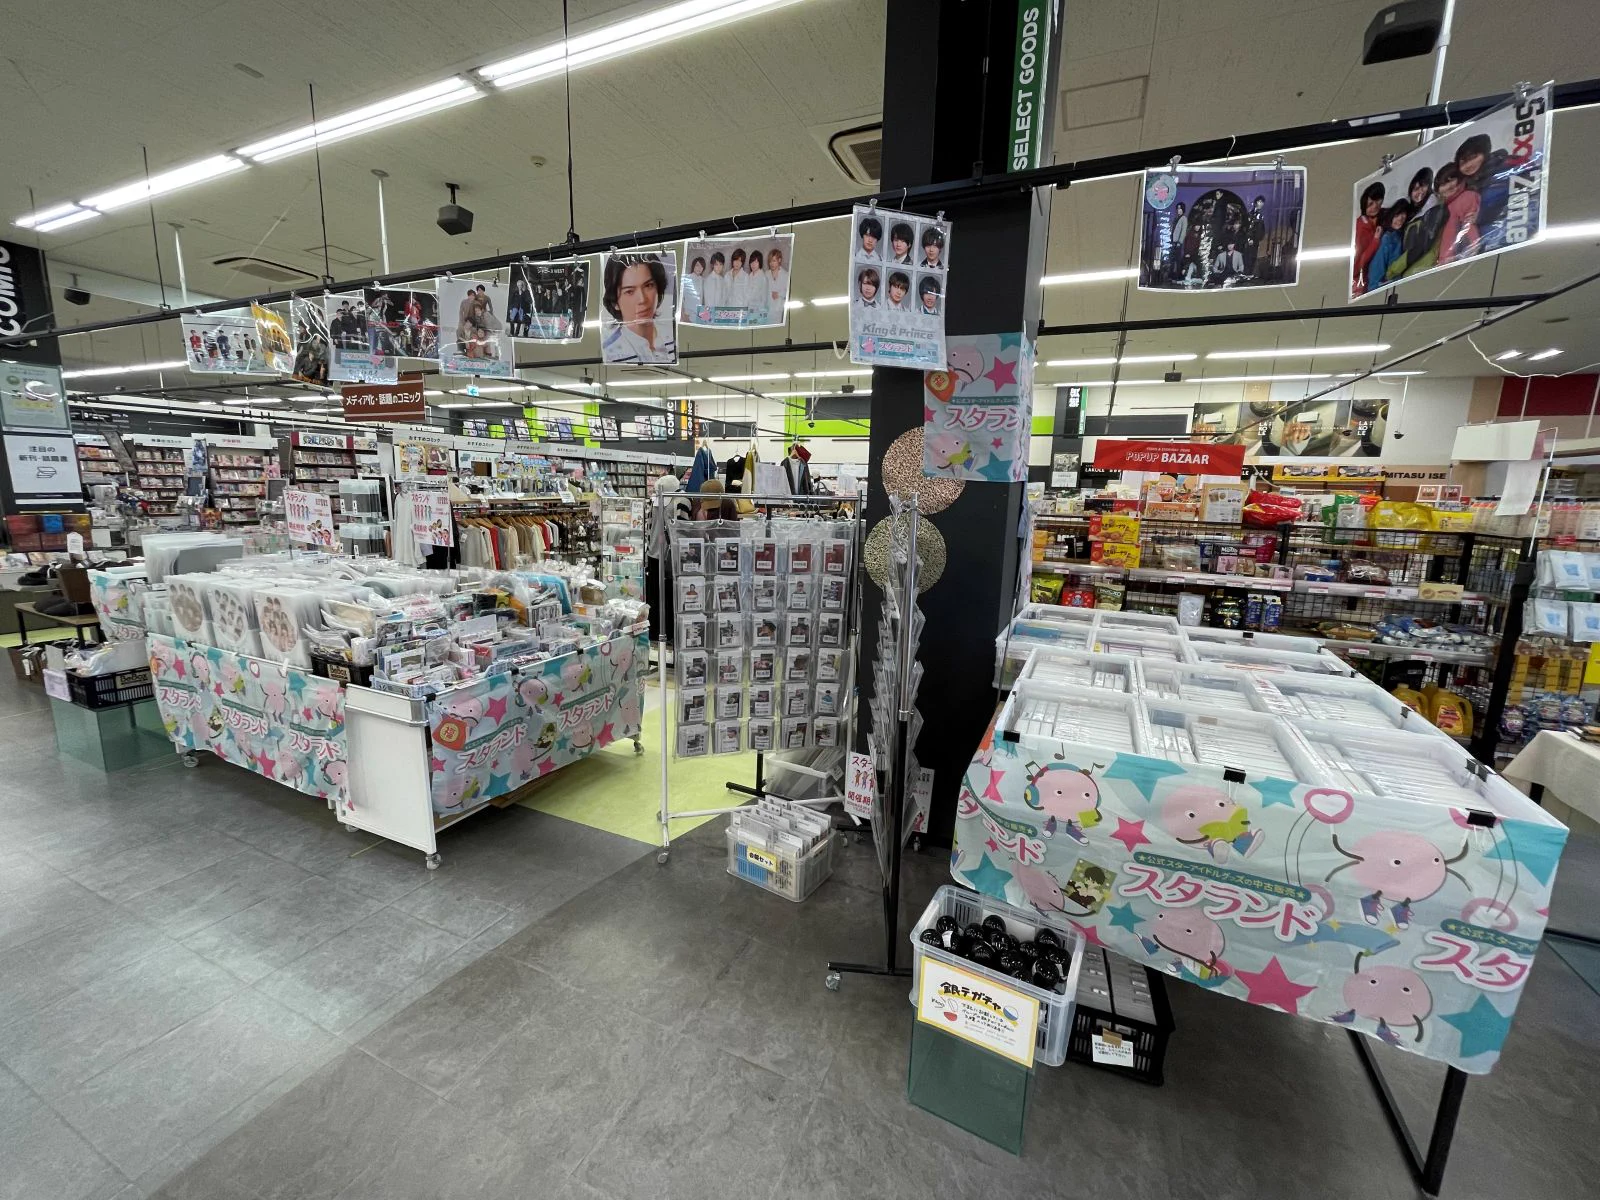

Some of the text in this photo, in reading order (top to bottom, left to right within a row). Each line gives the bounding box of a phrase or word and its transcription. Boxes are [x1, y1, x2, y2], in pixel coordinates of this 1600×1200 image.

[1013, 7, 1039, 171] SELECT GOODS
[1505, 96, 1545, 244] Sexy Zone
[862, 323, 934, 340] King & Prince
[667, 401, 675, 436] COMIC
[408, 435, 441, 443] おすすめコミック
[1126, 452, 1210, 465] POPUP BAZAAR
[1428, 472, 1447, 480] ISE
[560, 692, 615, 728] スタランド
[458, 723, 529, 771] スタランド
[847, 791, 873, 806] 開催期
[1147, 855, 1297, 898] 公式スターアイドルグッズの中古販売
[1122, 864, 1318, 938] スタランド
[1420, 934, 1528, 987] スタ
[940, 981, 1002, 1011] 銀テガチャ
